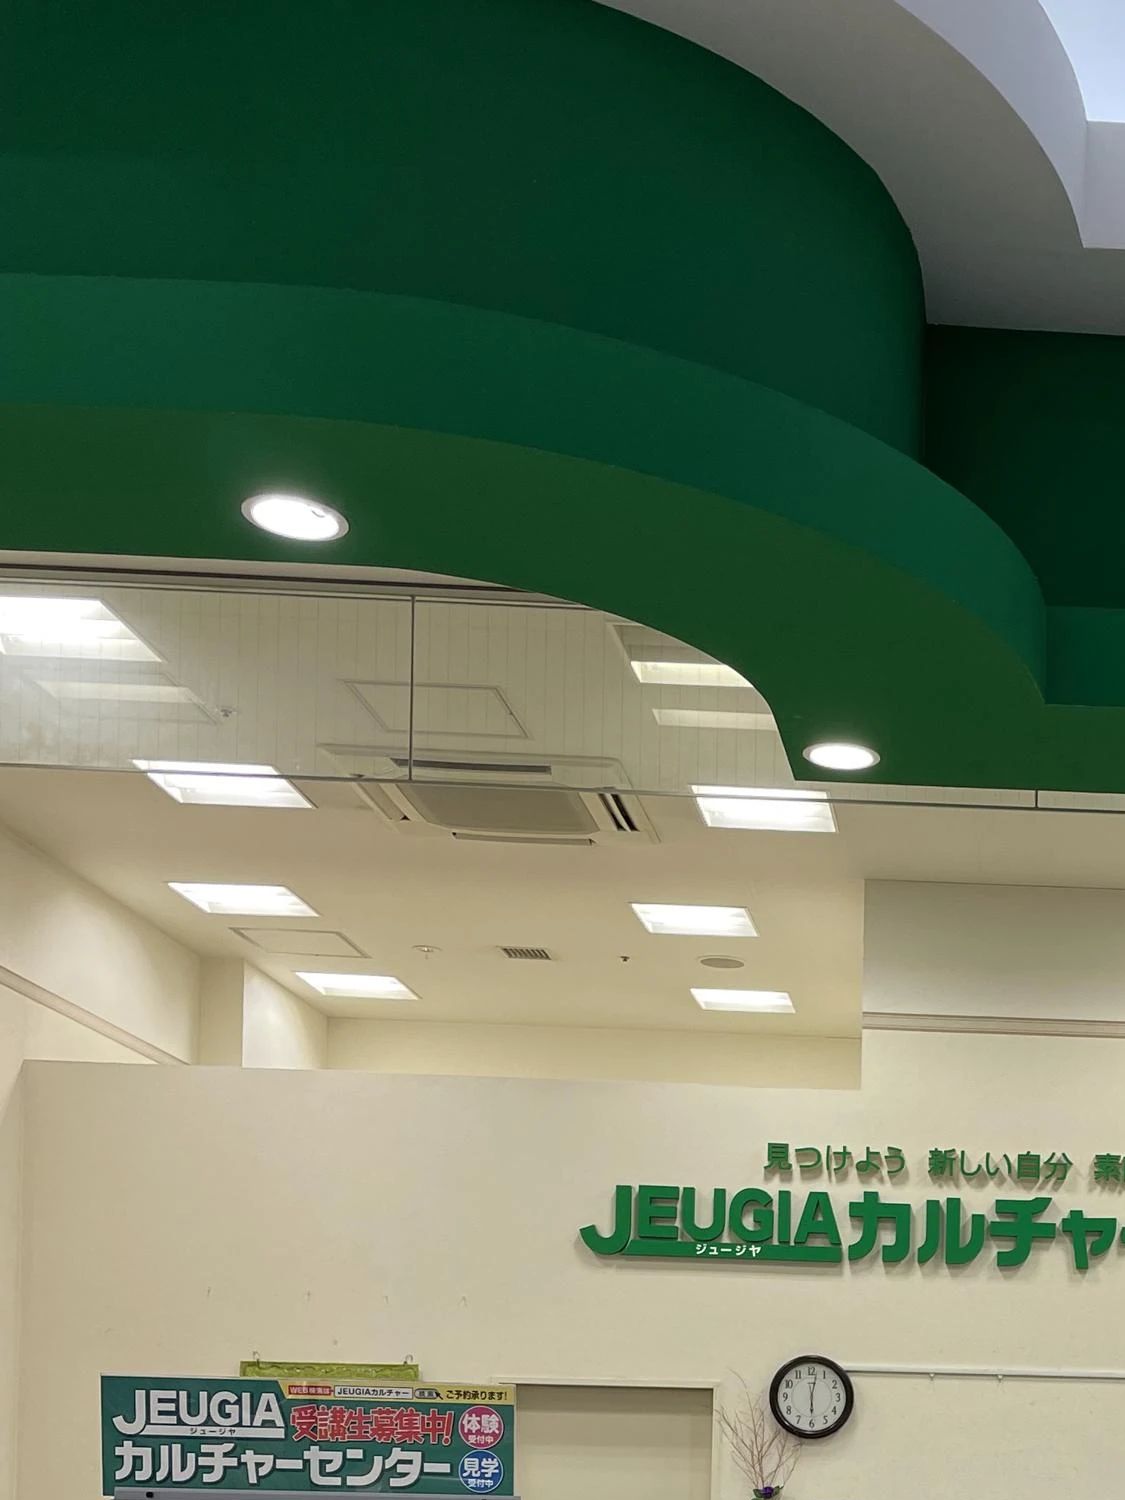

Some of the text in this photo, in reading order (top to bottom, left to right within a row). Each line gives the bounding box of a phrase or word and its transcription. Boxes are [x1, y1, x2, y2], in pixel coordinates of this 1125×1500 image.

[764, 1142, 905, 1176] 見つけよう
[927, 1147, 1073, 1181] 新しい自分
[795, 1370, 801, 1379] 11
[808, 1367, 816, 1375] 12
[823, 1370, 826, 1379] 1
[786, 1380, 793, 1389] 10
[832, 1380, 837, 1389] 2
[337, 1388, 410, 1397] JEUGIAカルチャー
[783, 1392, 788, 1401] 9
[835, 1393, 841, 1402] 3
[112, 1389, 285, 1436] JEUGIA
[786, 1405, 791, 1415] 8
[831, 1406, 837, 1415] 4
[462, 1413, 500, 1434] 体験
[796, 1415, 801, 1424] 7
[809, 1419, 815, 1428] 6
[823, 1416, 828, 1424] 5
[290, 1404, 455, 1446] 受講生募集中!
[468, 1435, 494, 1444] 受付中
[113, 1441, 451, 1487] カルチャーセンター
[462, 1457, 500, 1477] 見学
[468, 1479, 494, 1488] 受付中
